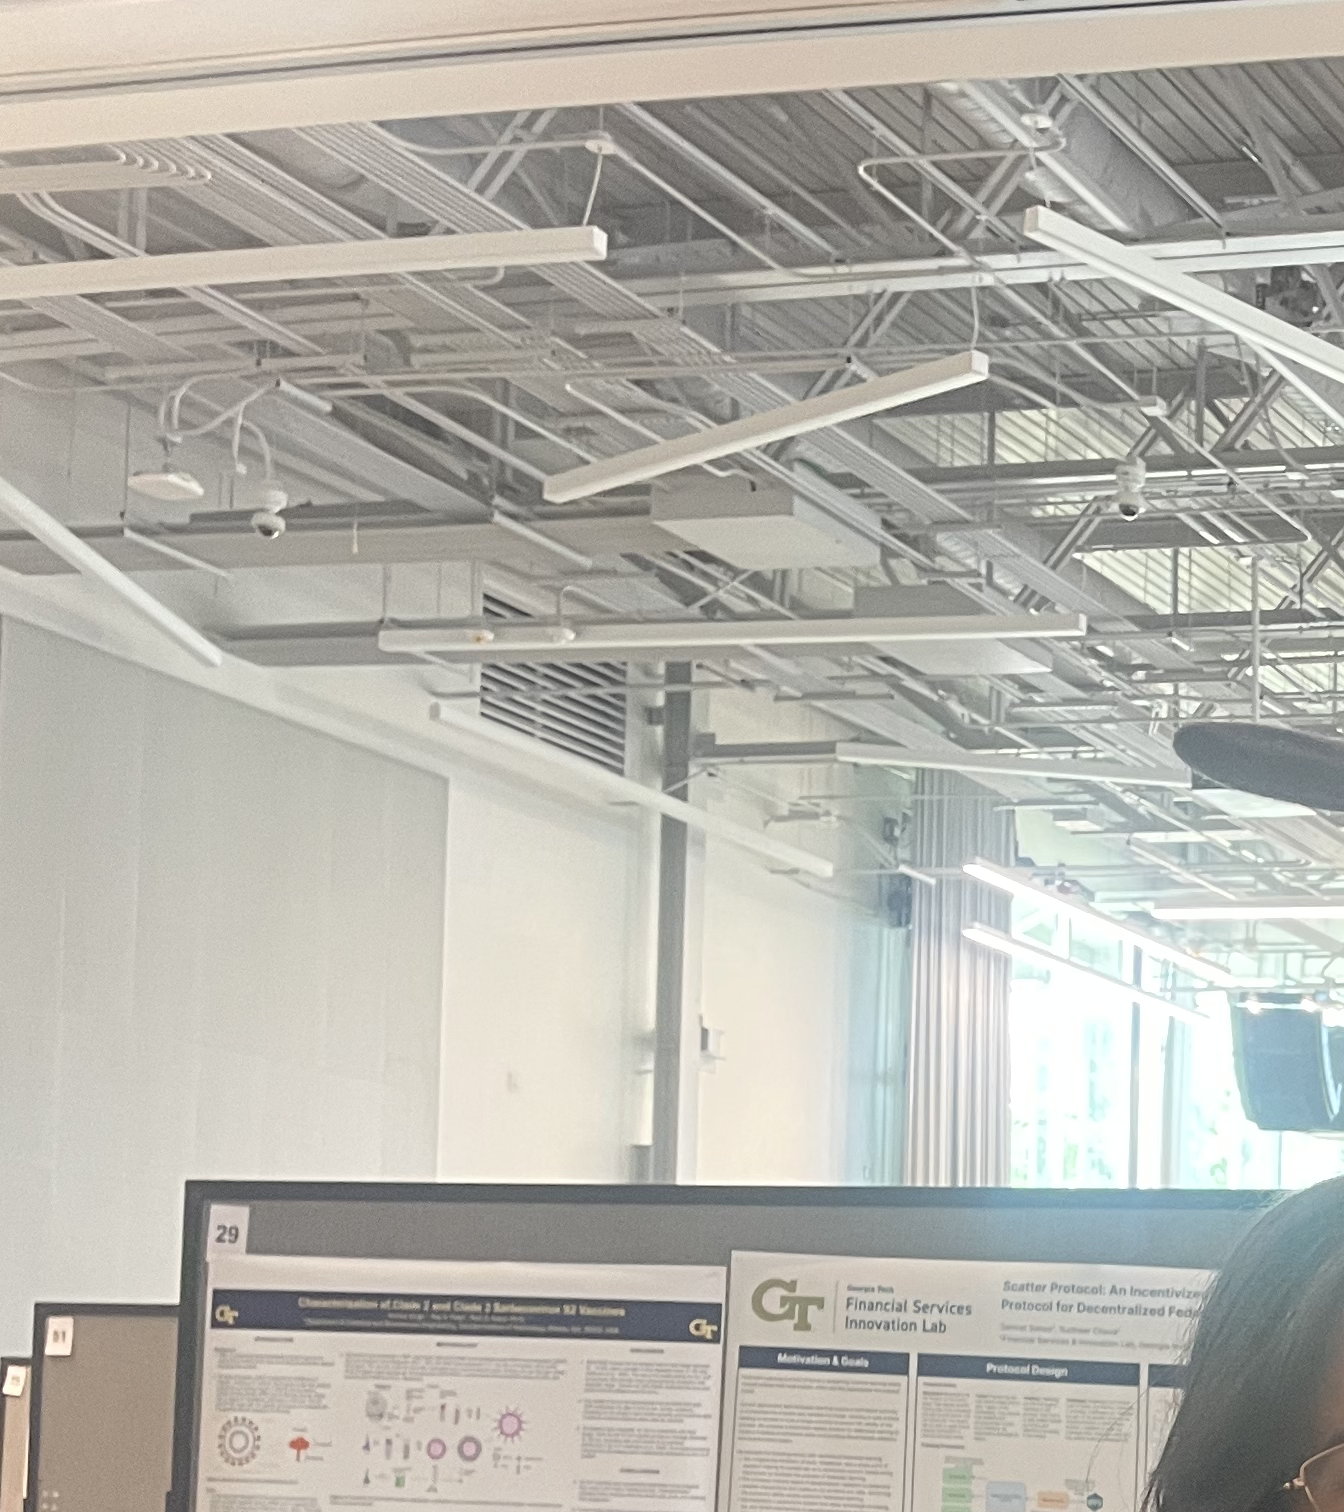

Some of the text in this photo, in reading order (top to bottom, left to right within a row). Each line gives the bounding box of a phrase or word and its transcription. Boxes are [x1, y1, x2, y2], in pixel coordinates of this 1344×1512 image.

[215, 1224, 239, 1244] 29
[1003, 1281, 1047, 1293] Scatter
[1109, 1284, 1127, 1297] An
[752, 1278, 825, 1332] GT
[845, 1297, 973, 1316] Financial Services
[1001, 1299, 1053, 1312] Protocol
[1056, 1300, 1074, 1313] for
[1077, 1302, 1165, 1318] Decentralized
[845, 1317, 947, 1334] Innovation Lab
[986, 1362, 1068, 1379] Protocol Design
